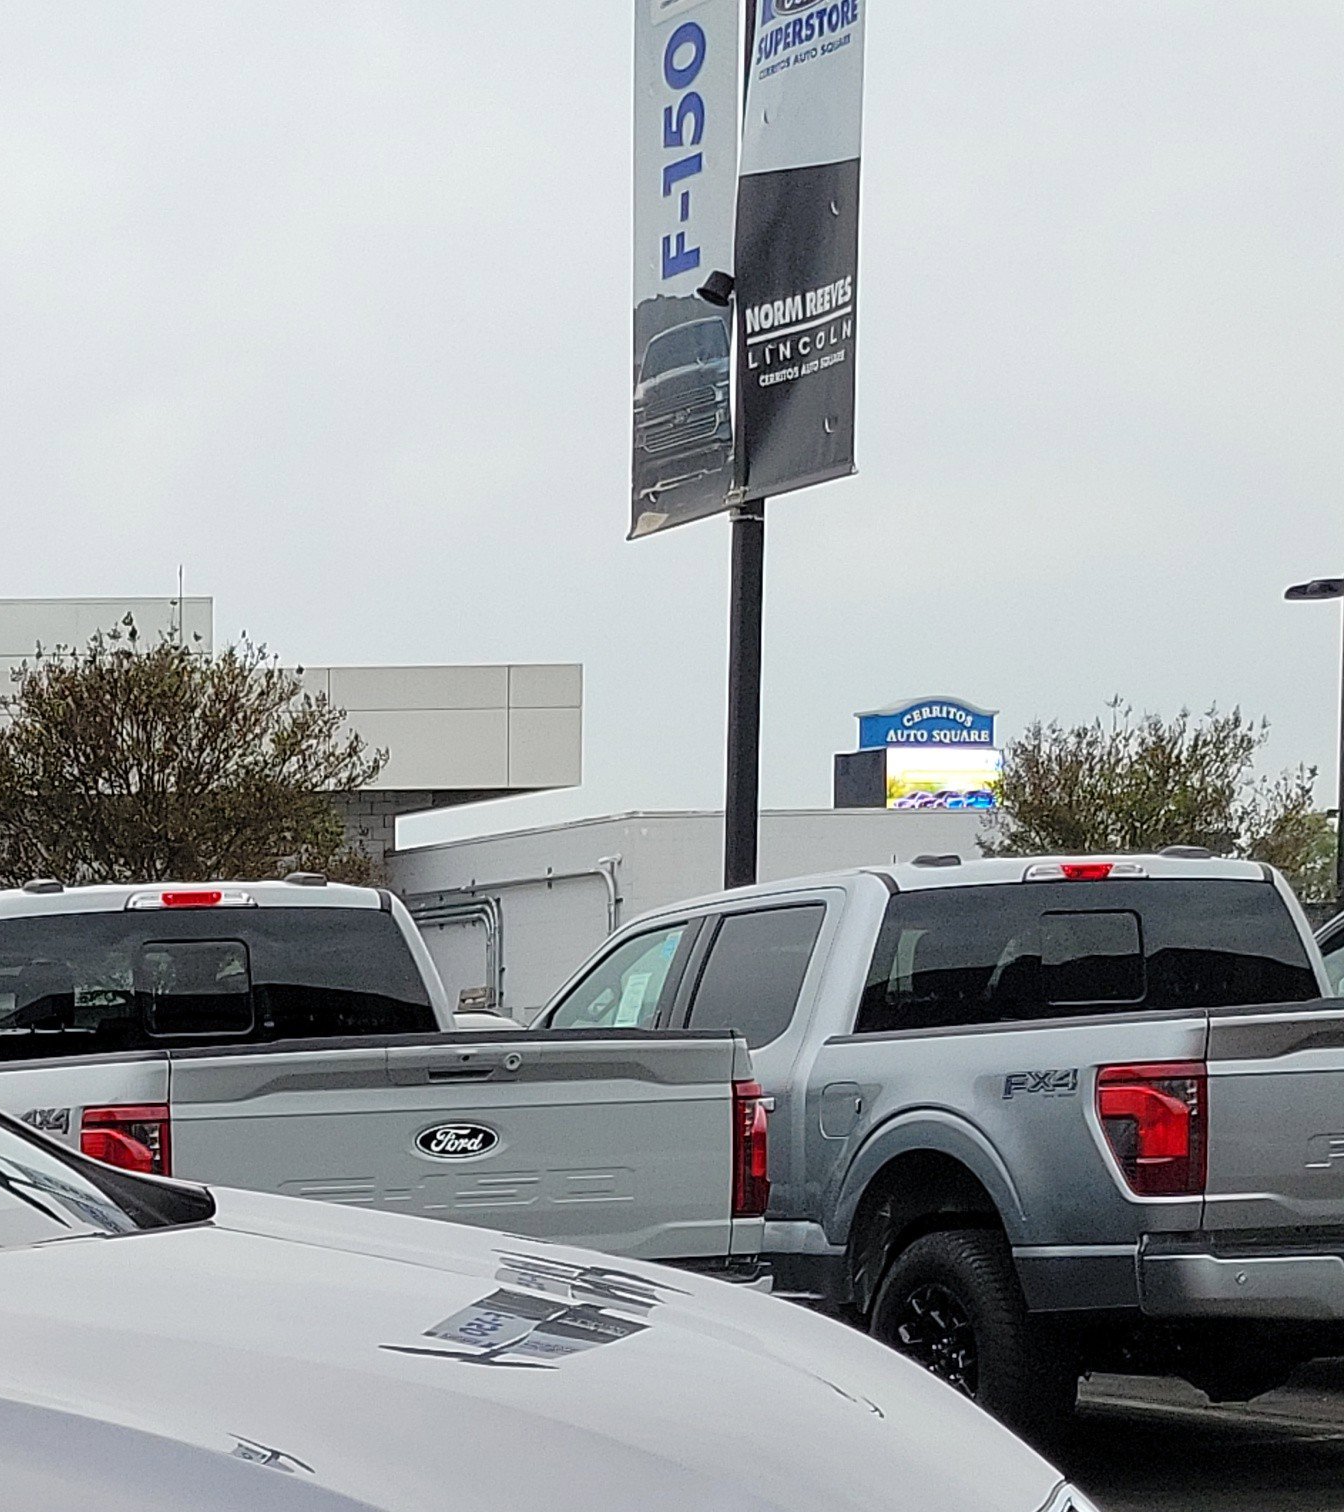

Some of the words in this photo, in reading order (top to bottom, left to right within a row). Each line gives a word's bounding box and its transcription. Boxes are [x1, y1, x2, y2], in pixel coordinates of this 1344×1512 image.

[755, 0, 858, 65] SUPERSTORE
[793, 48, 818, 65] AUTO
[662, 21, 707, 280] F-150
[745, 295, 803, 335] NORM
[805, 275, 852, 318] REEVES
[747, 319, 852, 370] LINCOLN
[902, 705, 973, 727] CERRITOS
[886, 729, 929, 742] AUTO
[931, 729, 990, 744] SQUARE
[1002, 1067, 1079, 1100] FX4
[430, 1128, 484, 1153] Ford
